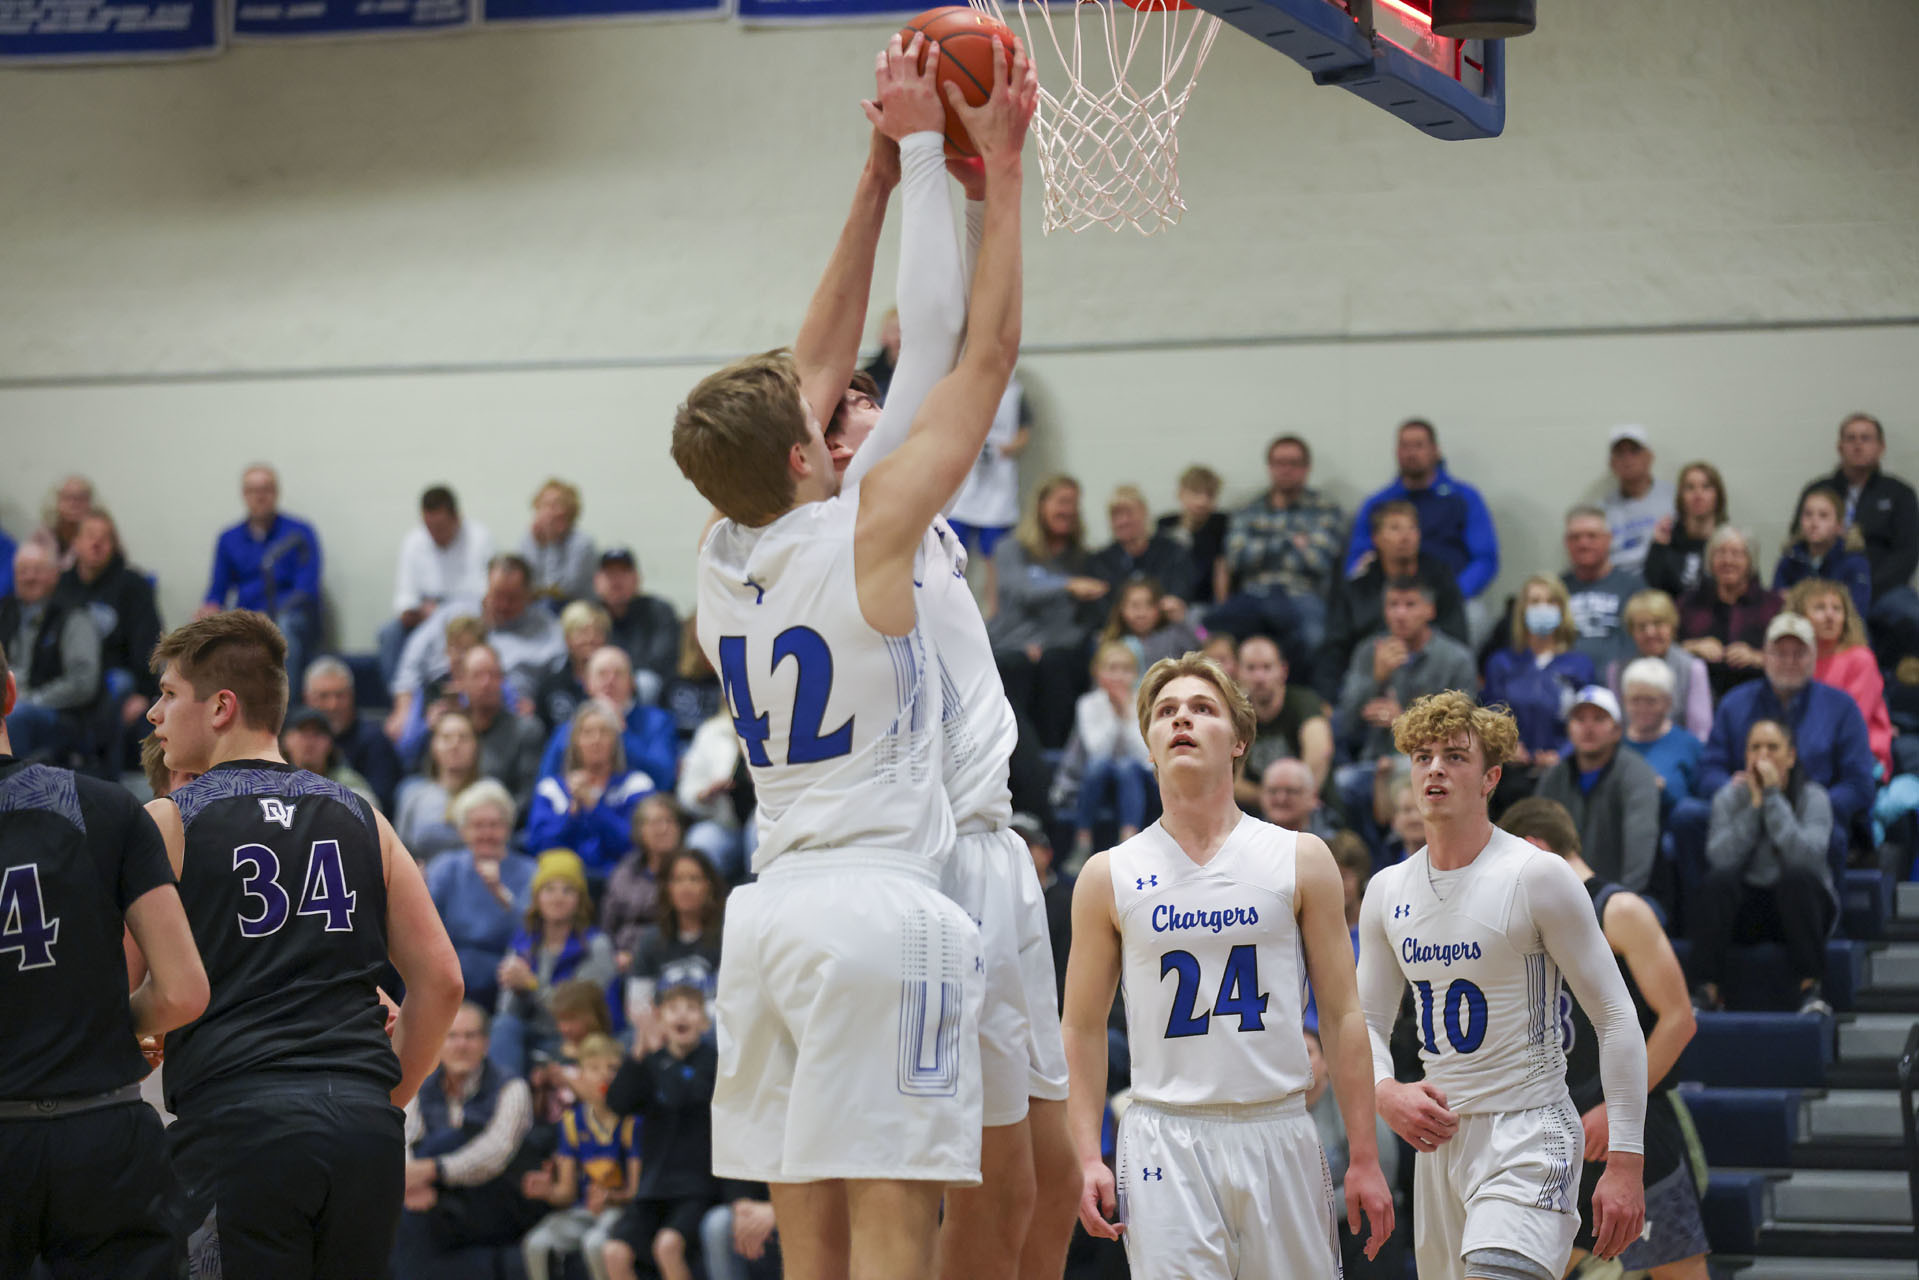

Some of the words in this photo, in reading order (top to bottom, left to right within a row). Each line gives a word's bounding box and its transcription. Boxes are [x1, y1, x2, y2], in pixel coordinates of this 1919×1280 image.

[719, 625, 855, 767] 42
[258, 797, 296, 830] DV
[0, 863, 60, 971] 4
[233, 840, 356, 937] 34
[1152, 904, 1259, 933] Chargers
[1160, 944, 1270, 1039] 24
[1402, 937, 1482, 966] Chargers
[1411, 978, 1488, 1054] 10
